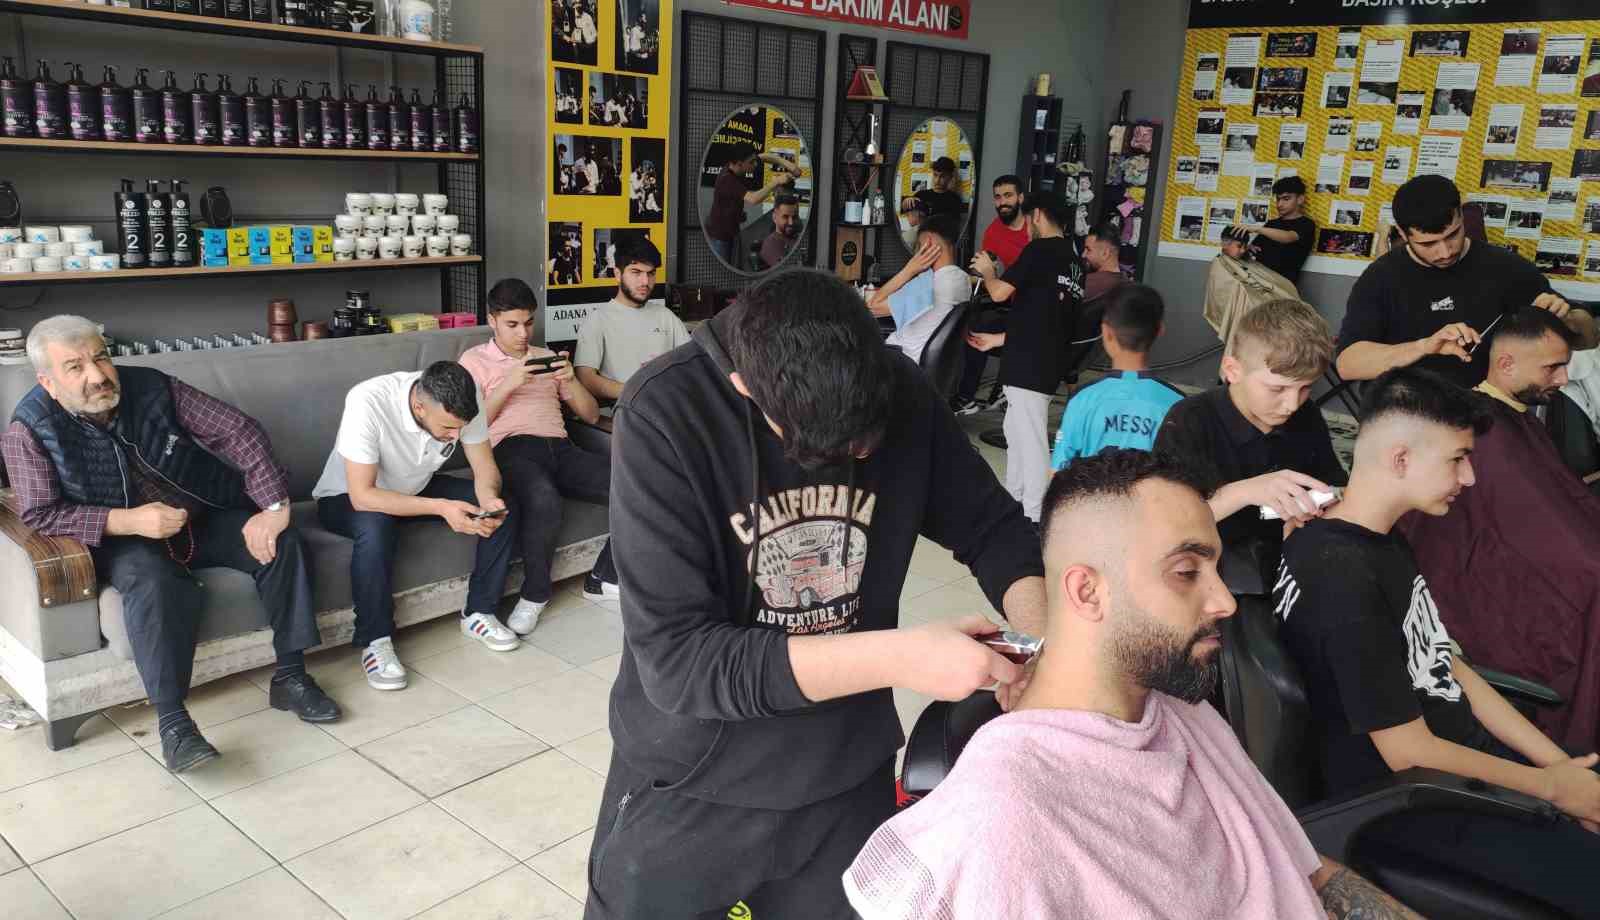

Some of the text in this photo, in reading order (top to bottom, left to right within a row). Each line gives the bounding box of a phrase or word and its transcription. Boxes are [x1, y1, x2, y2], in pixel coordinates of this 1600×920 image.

[888, 0, 949, 31] ALANI
[127, 234, 139, 249] 2
[154, 232, 166, 248] 2
[176, 232, 189, 248] 2
[553, 308, 588, 321] ADANA
[756, 606, 835, 627] ADVENTURE
